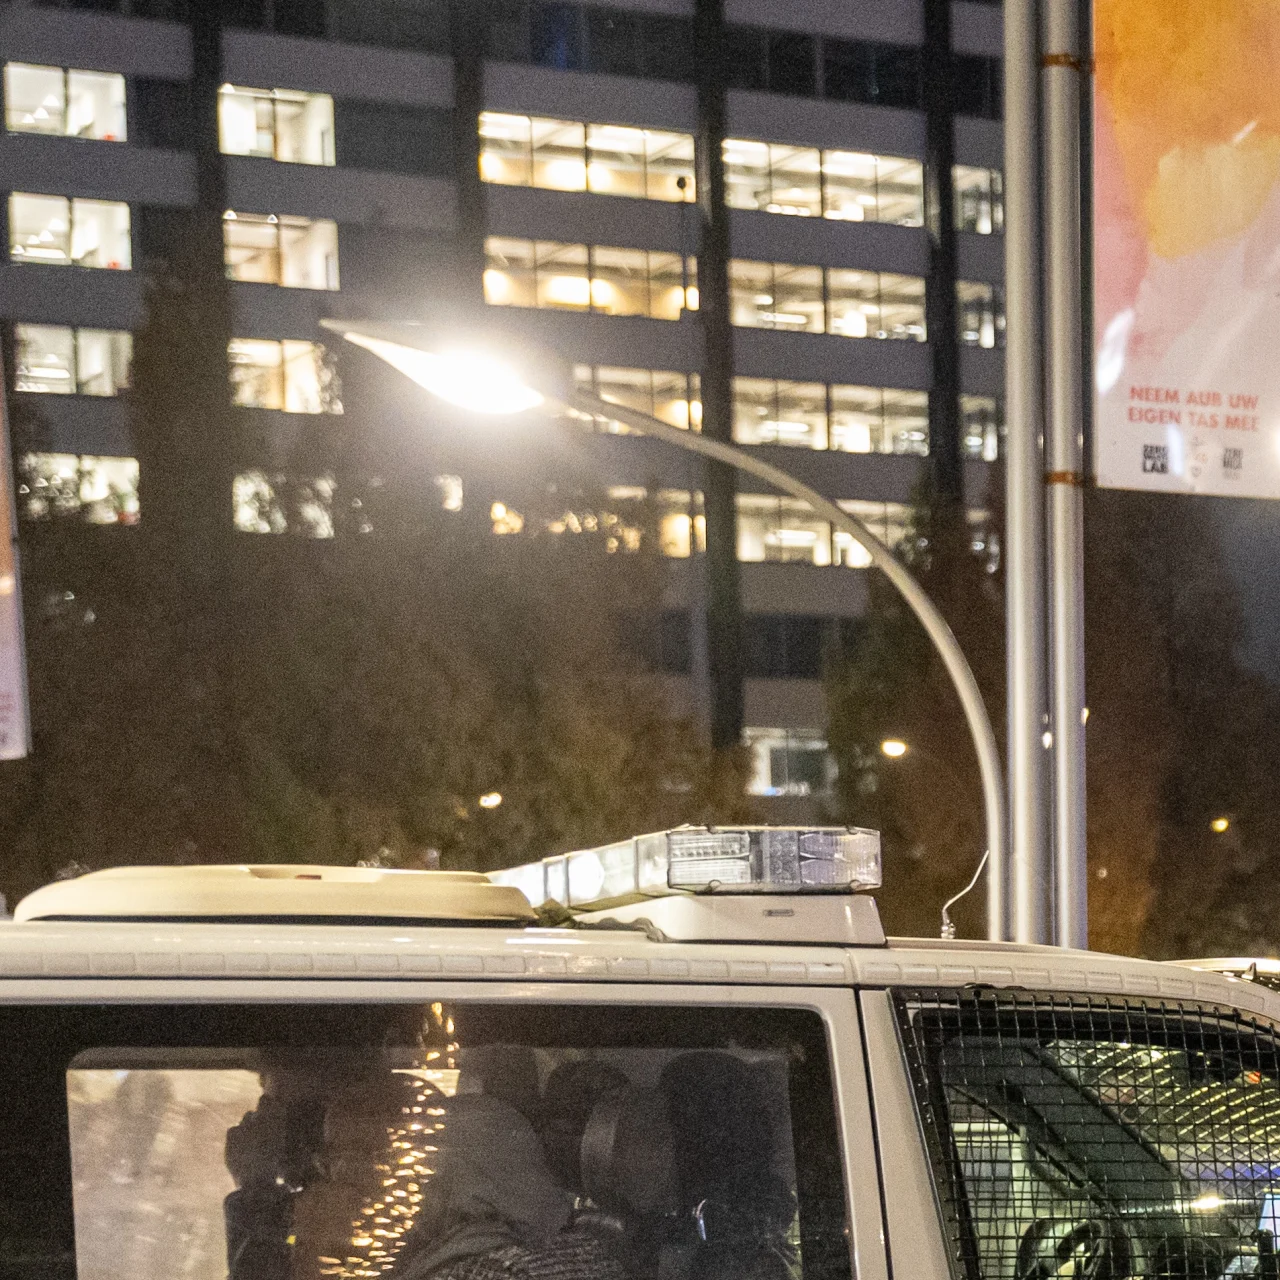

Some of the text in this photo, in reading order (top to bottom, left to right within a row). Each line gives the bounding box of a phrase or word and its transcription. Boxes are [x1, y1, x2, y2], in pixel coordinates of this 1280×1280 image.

[1129, 386, 1180, 403] NEEM
[1228, 394, 1259, 410] UW
[1128, 406, 1260, 432] EIGEN TAS MEE
